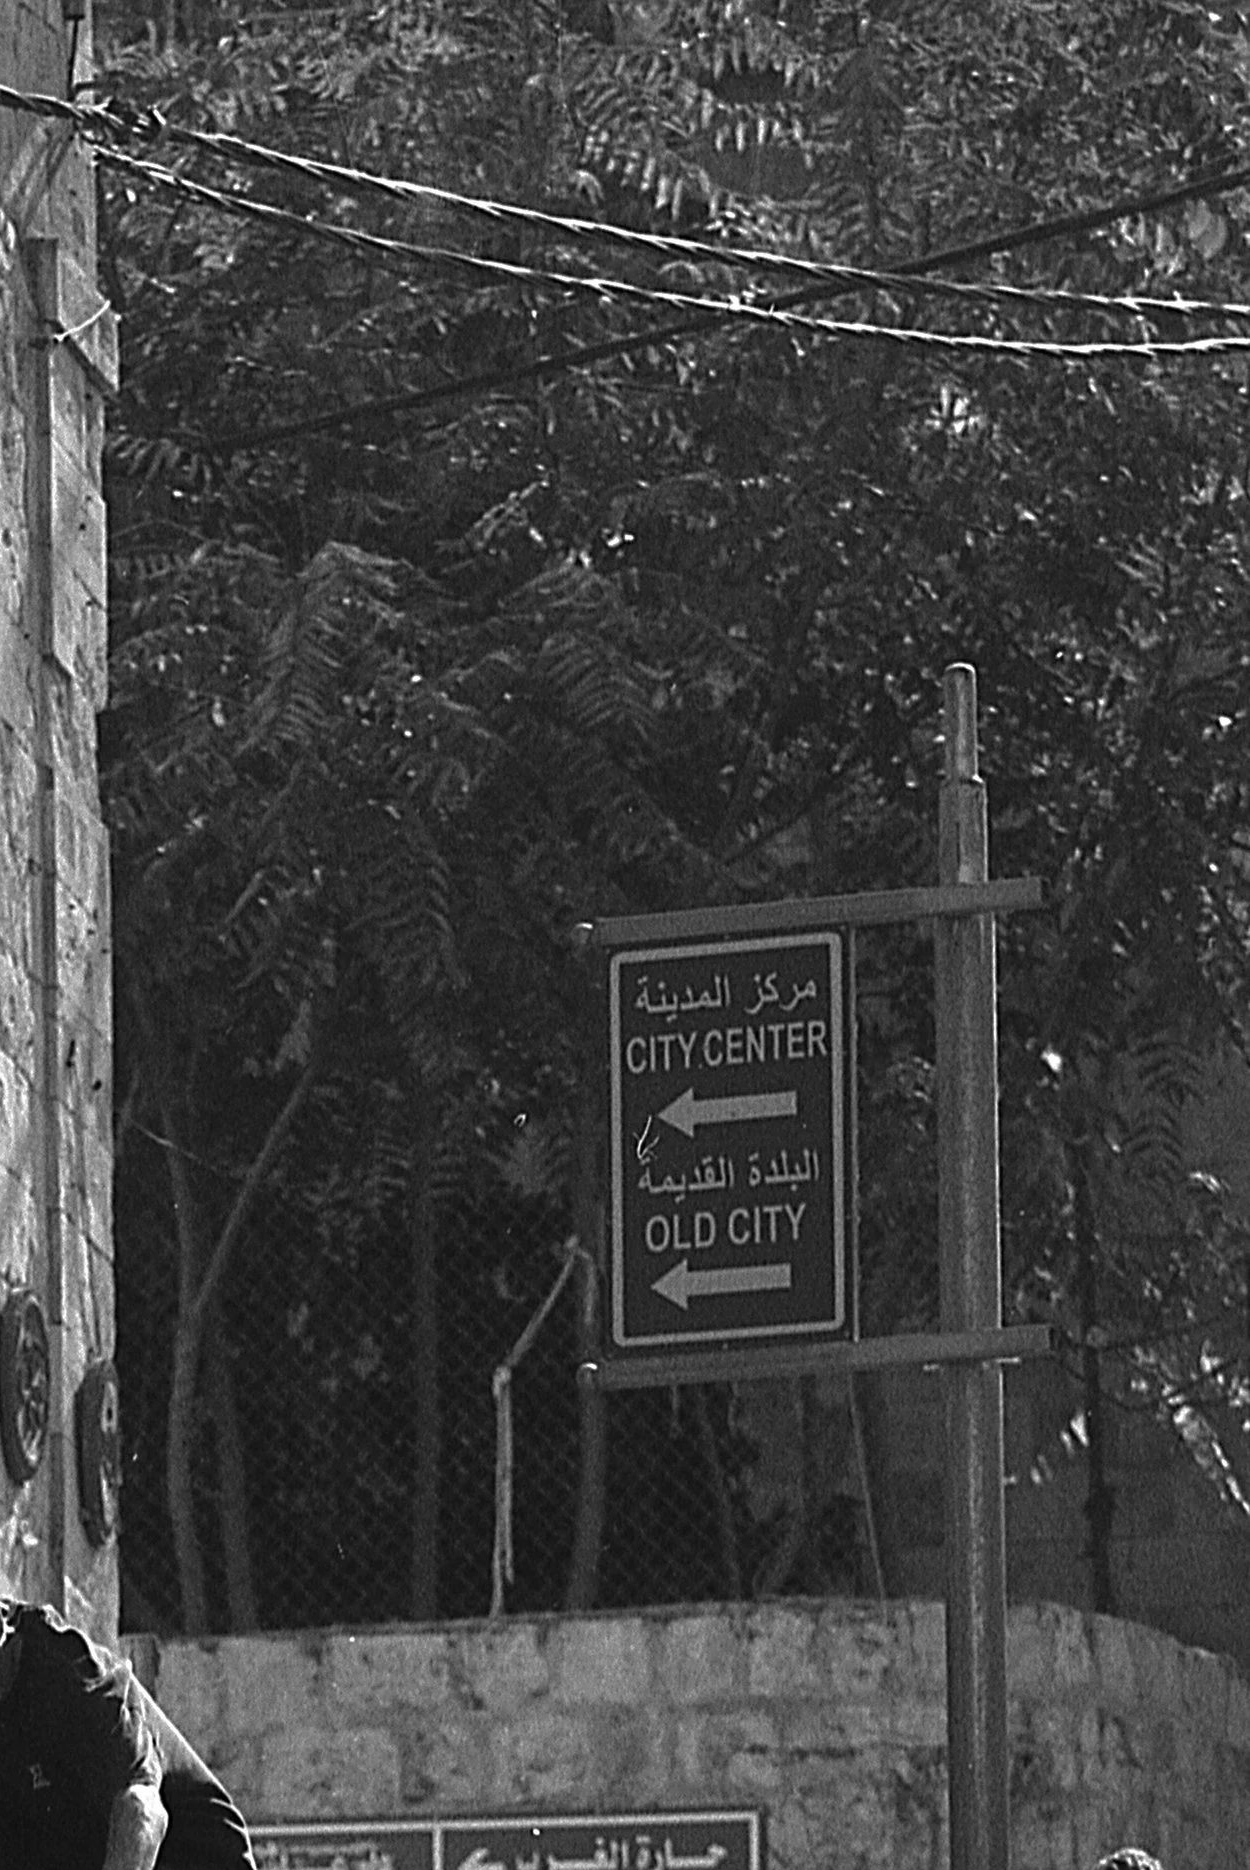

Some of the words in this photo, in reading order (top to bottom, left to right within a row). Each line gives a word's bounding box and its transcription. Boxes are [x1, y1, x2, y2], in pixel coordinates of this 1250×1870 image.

[634, 974, 731, 1022] المدينة
[744, 972, 817, 1016] مركز
[626, 1031, 698, 1074] CITY
[704, 1020, 828, 1067] CENTER
[638, 1153, 735, 1203] القديمة
[748, 1149, 820, 1191] البلدة
[645, 1210, 716, 1253] OLD
[728, 1203, 807, 1246] CITY
